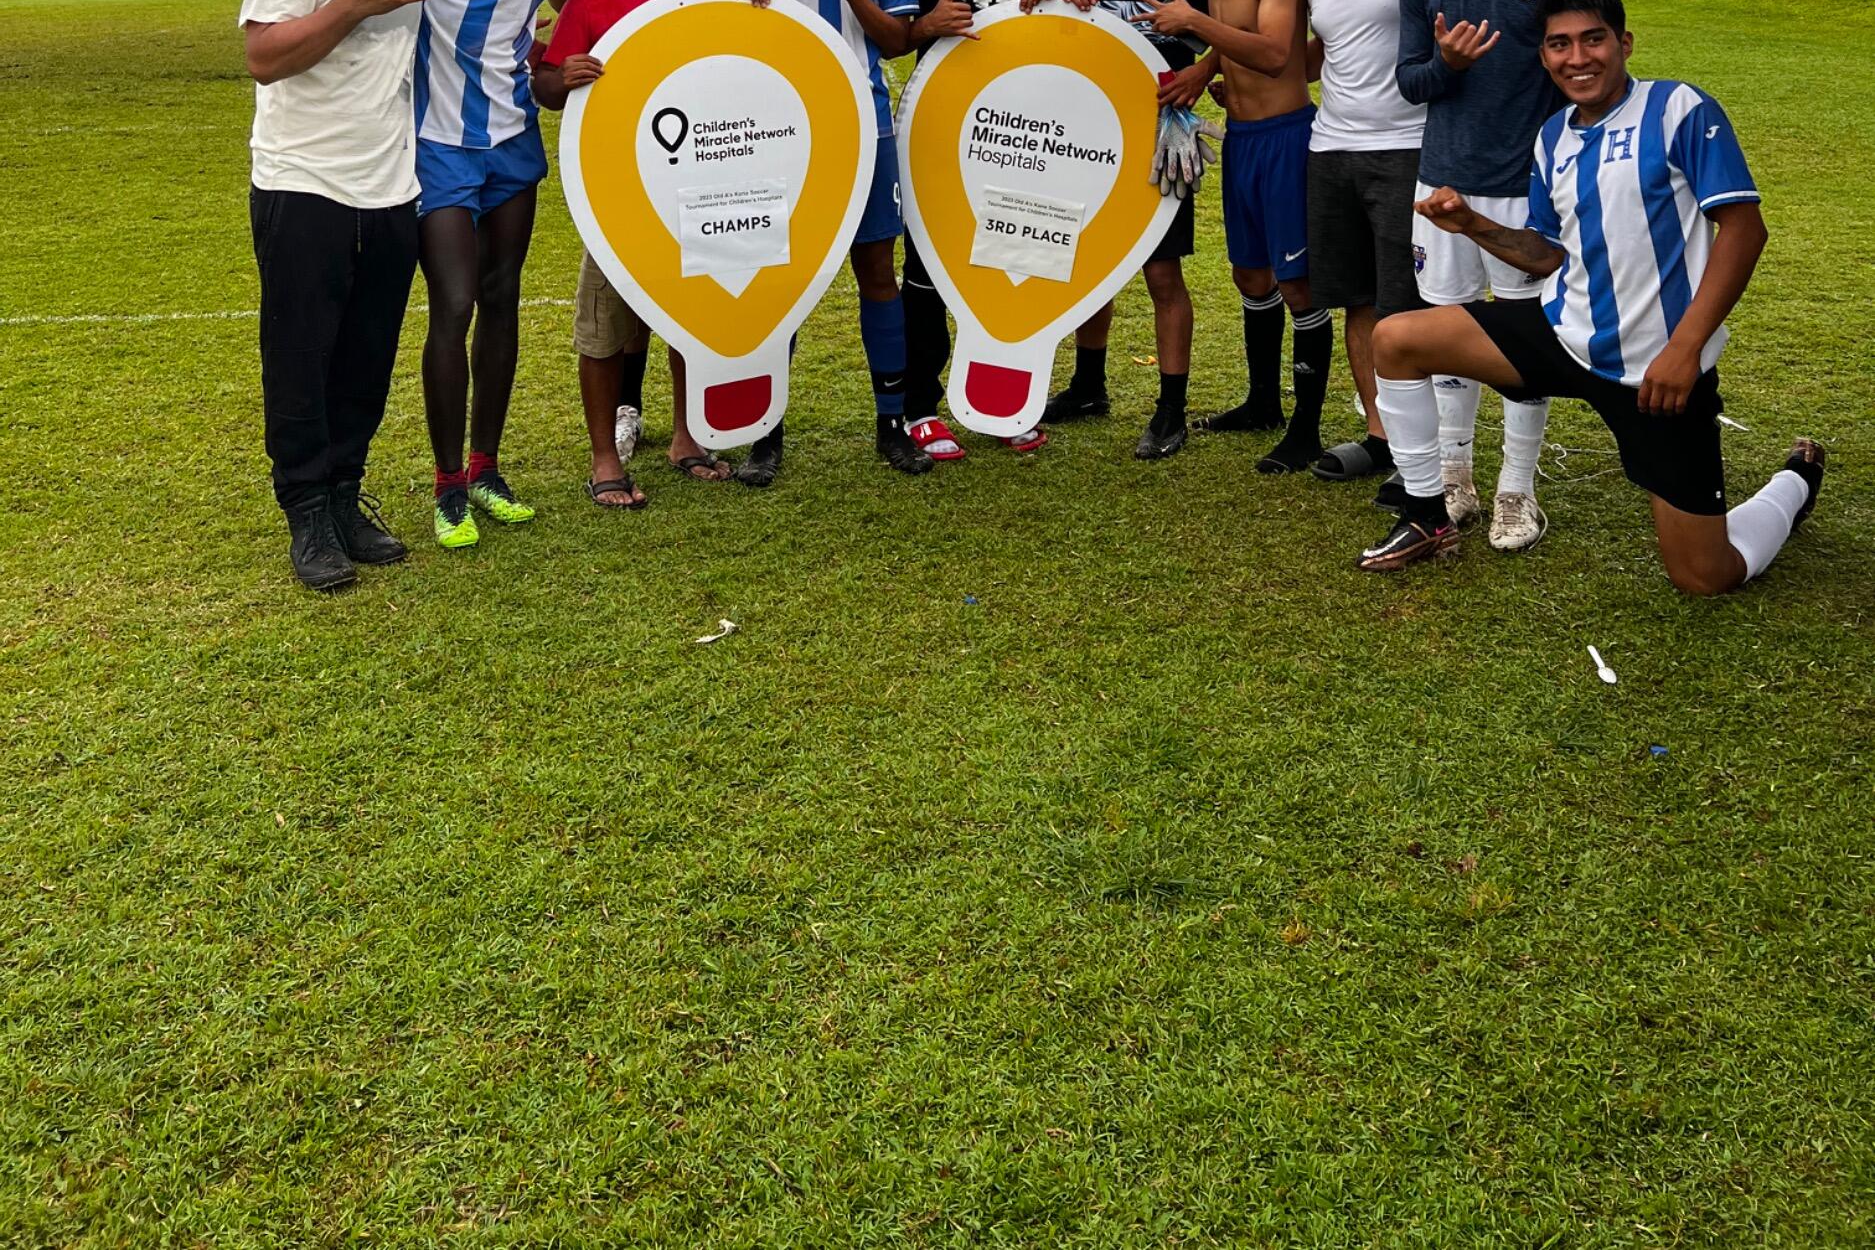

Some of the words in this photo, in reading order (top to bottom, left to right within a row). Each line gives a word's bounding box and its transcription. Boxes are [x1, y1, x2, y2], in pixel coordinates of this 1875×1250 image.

[693, 117, 756, 135] Children's
[975, 107, 1065, 137] Children's
[694, 133, 741, 148] Miracle
[744, 125, 796, 142] Network
[971, 125, 1039, 151] Miracle
[1042, 137, 1117, 165] Network
[1603, 125, 1637, 164] H
[695, 145, 754, 162] Hospitals
[968, 143, 1046, 172] Hospitals
[685, 201, 719, 210] Tournament
[729, 197, 757, 205] Children's
[757, 194, 783, 202] Hospitals
[987, 200, 1018, 211] Tournament
[1027, 207, 1053, 218] Children's
[1053, 213, 1078, 222] Hospitals
[1048, 205, 1066, 213] Soccer
[701, 215, 771, 235] CHAMPS
[985, 219, 1017, 235] 3RD
[1021, 226, 1071, 246] PLACE
